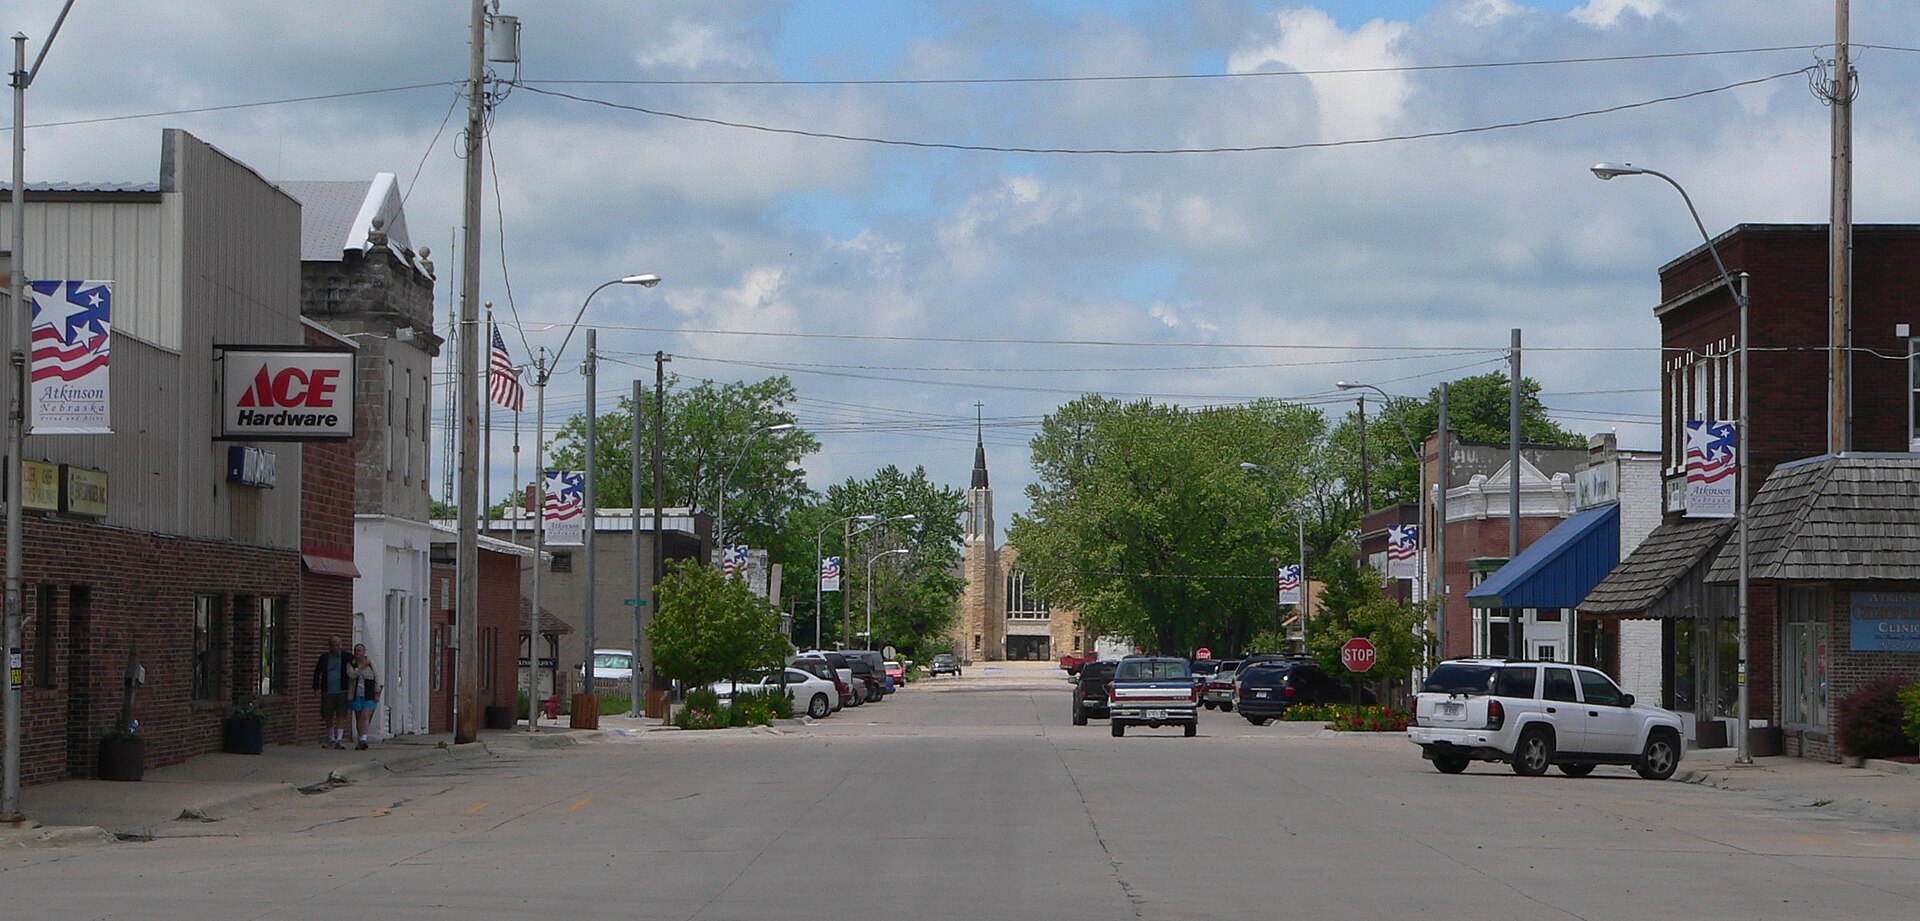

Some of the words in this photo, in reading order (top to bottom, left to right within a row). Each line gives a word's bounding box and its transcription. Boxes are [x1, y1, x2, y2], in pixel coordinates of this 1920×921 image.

[237, 361, 340, 408] ACE
[39, 384, 104, 402] Atkinson
[40, 402, 105, 415] Nebraska
[237, 409, 338, 427] Hardware
[1691, 485, 1731, 497] Atkinson
[1343, 648, 1374, 662] STOP
